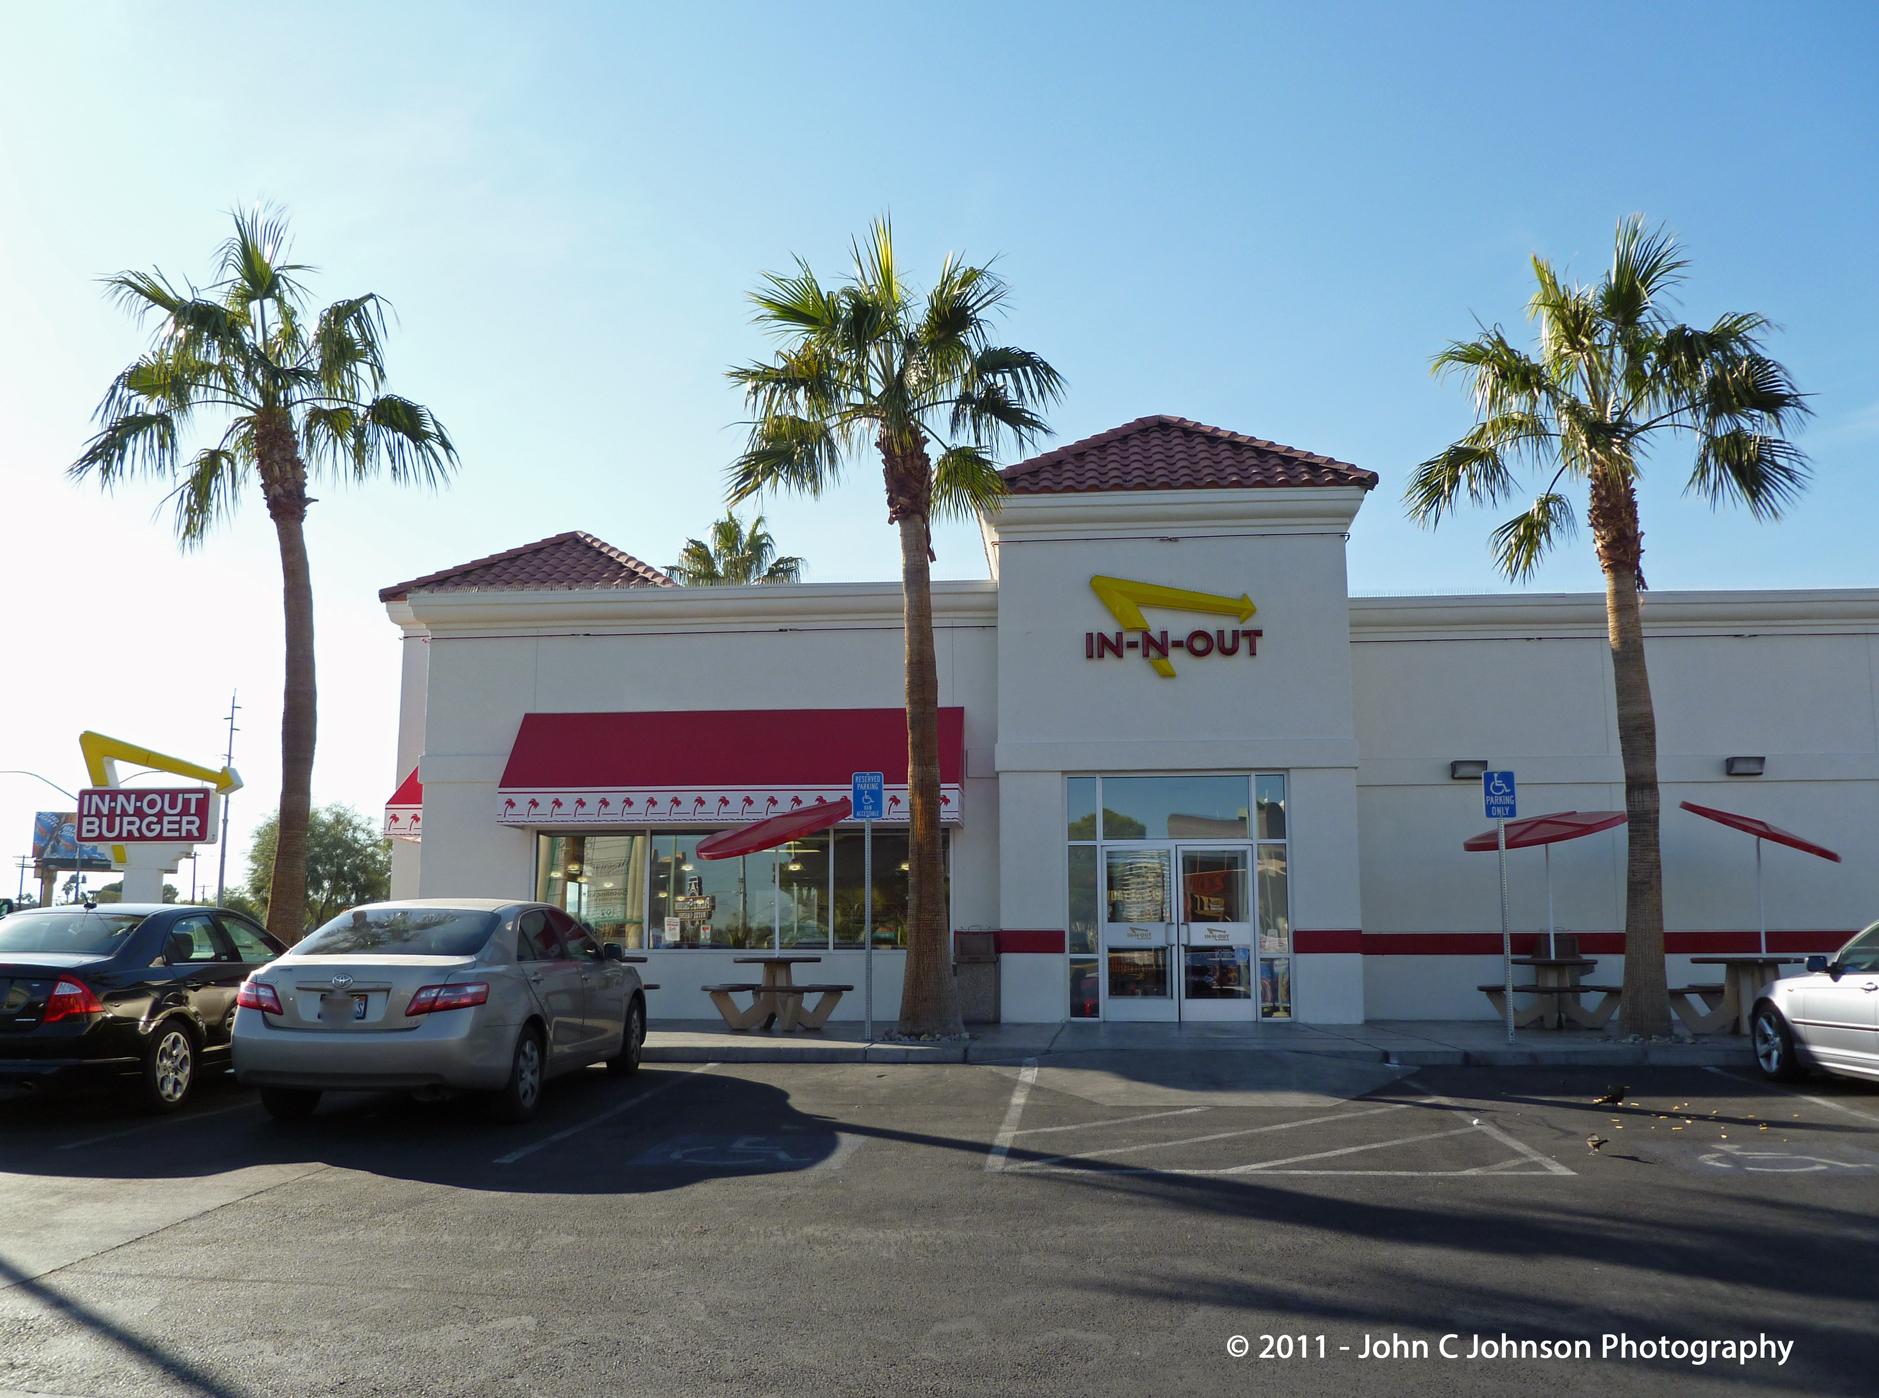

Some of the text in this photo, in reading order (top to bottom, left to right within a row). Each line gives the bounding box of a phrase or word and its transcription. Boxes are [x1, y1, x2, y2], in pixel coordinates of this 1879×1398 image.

[1086, 630, 1263, 658] IN-N-OUT
[83, 793, 204, 815] IN-N-OUT
[1486, 795, 1514, 805] PARKING
[1491, 806, 1509, 816] ONLY
[82, 816, 200, 838] BURGER
